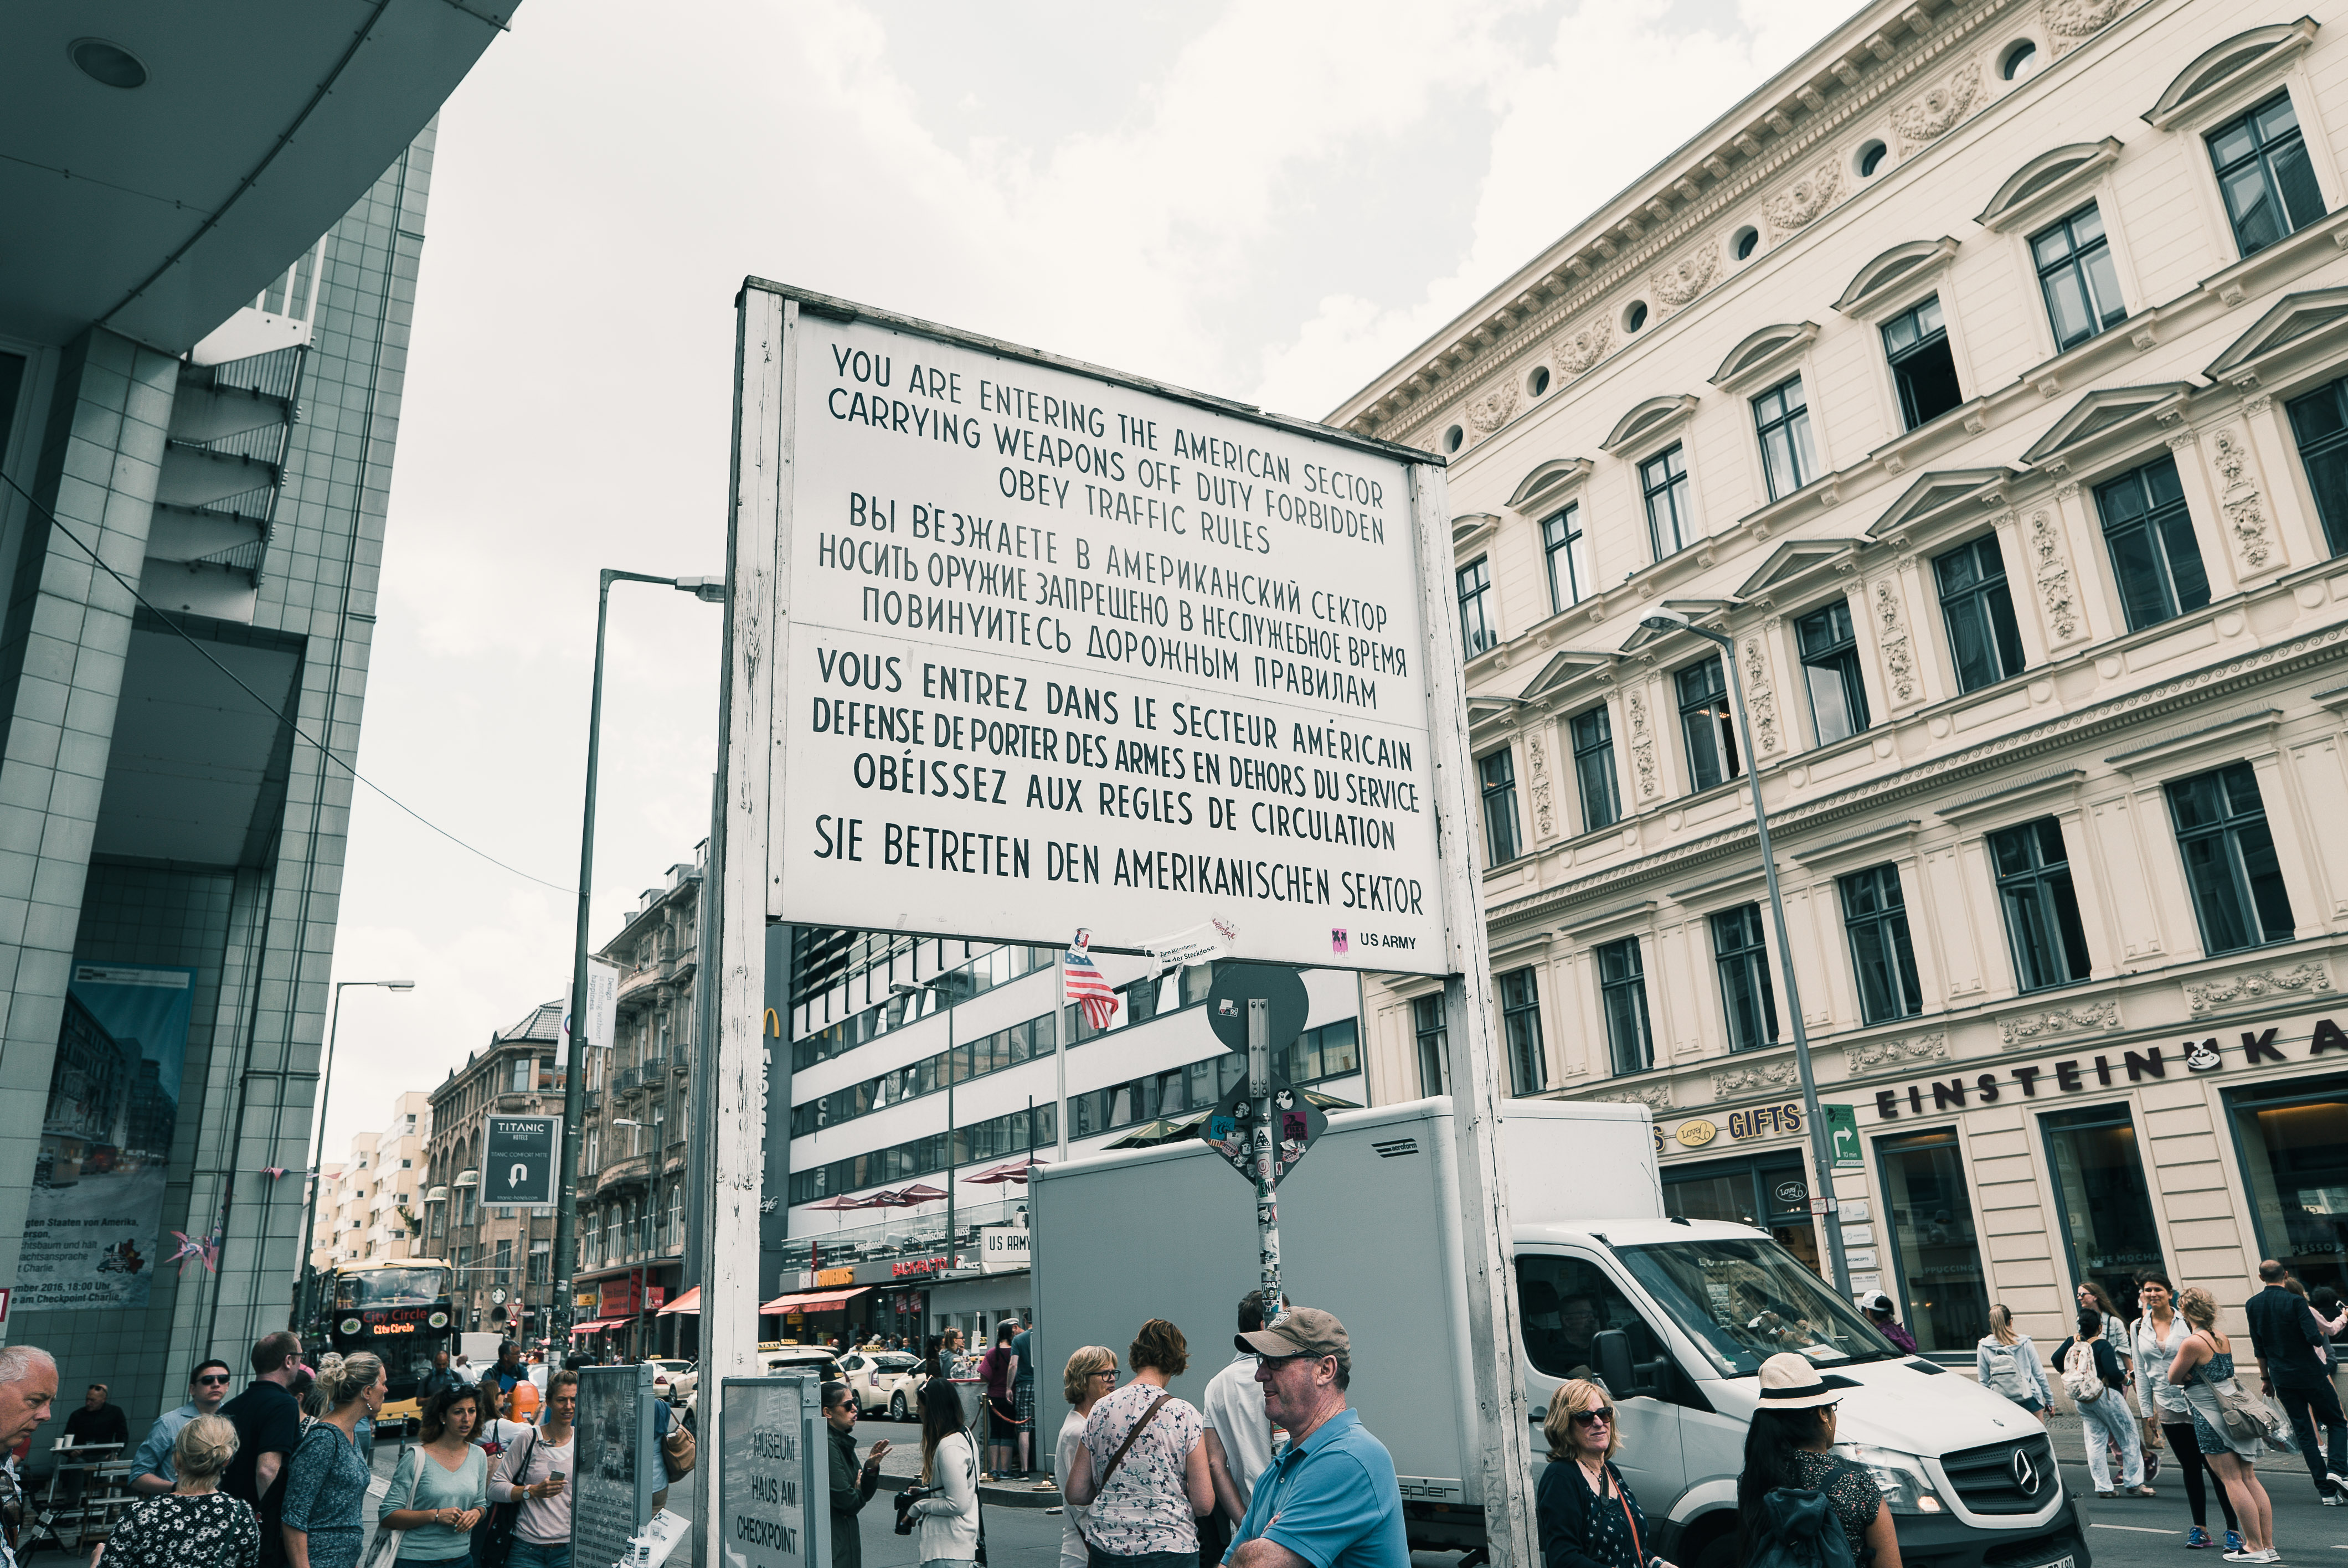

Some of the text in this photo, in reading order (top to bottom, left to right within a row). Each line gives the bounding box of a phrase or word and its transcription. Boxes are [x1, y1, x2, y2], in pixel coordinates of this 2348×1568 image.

[832, 344, 1382, 509] YOU ARE ENTERING THE AMERICAN SECTOR
[828, 388, 1383, 545] CARRYING WEAPONS OFF DUTY FORBIDDEN
[1000, 467, 1269, 554] OBEY TRAFFIC RULES
[851, 492, 894, 533] ВЫ
[1077, 538, 1090, 569] В
[1107, 545, 1300, 614] АМЕРИКАНСКИЙ
[1312, 591, 1386, 633] СЕКТОР
[820, 533, 1407, 677] НОСИТЬ ОРУЖИЕ ЗАПРЕЩЕНО В НЕСЛУЖЕБНОЕ ВРЕМЯ
[1087, 626, 1238, 682] ДОРОЖНЫМ
[1255, 656, 1376, 709] ПРАВИЛАМ
[817, 648, 1412, 771] VOUS ENTREZ DANS LE SECTEUR AMÉRICAIN
[813, 697, 1419, 813] DEFENSE DE PORTER DES ARMES EN DEHORS DU SERVICE
[854, 749, 1394, 850] OBÉISSEZ AUX REGLES DE CIRCULATION
[814, 814, 1423, 915] SIE BETRETEN DEN AMERIKANISCHEN SEKTOR
[1360, 932, 1416, 950] US ARMY
[1876, 1046, 2165, 1118] EINSTEIN
[498, 1122, 544, 1132] TITANIC
[1728, 1103, 1802, 1141] GIFTS
[47, 1218, 81, 1227] Staaten
[101, 1218, 138, 1227] Amerika,
[990, 1236, 1002, 1250] US
[37, 1294, 86, 1304] Checkpoint
[88, 1293, 122, 1303] Charlie.
[42, 1283, 65, 1292] 2016,
[68, 1282, 92, 1291] 18:00
[95, 1282, 110, 1290] Uhr
[363, 1311, 388, 1324] City
[392, 1308, 428, 1321] Circle
[374, 1323, 415, 1334] City Circle
[754, 1432, 795, 1462] MUSEUM
[751, 1475, 796, 1508] HAUS AM
[1399, 1479, 1460, 1499] spier
[737, 1514, 797, 1555] CHECKPOINT
